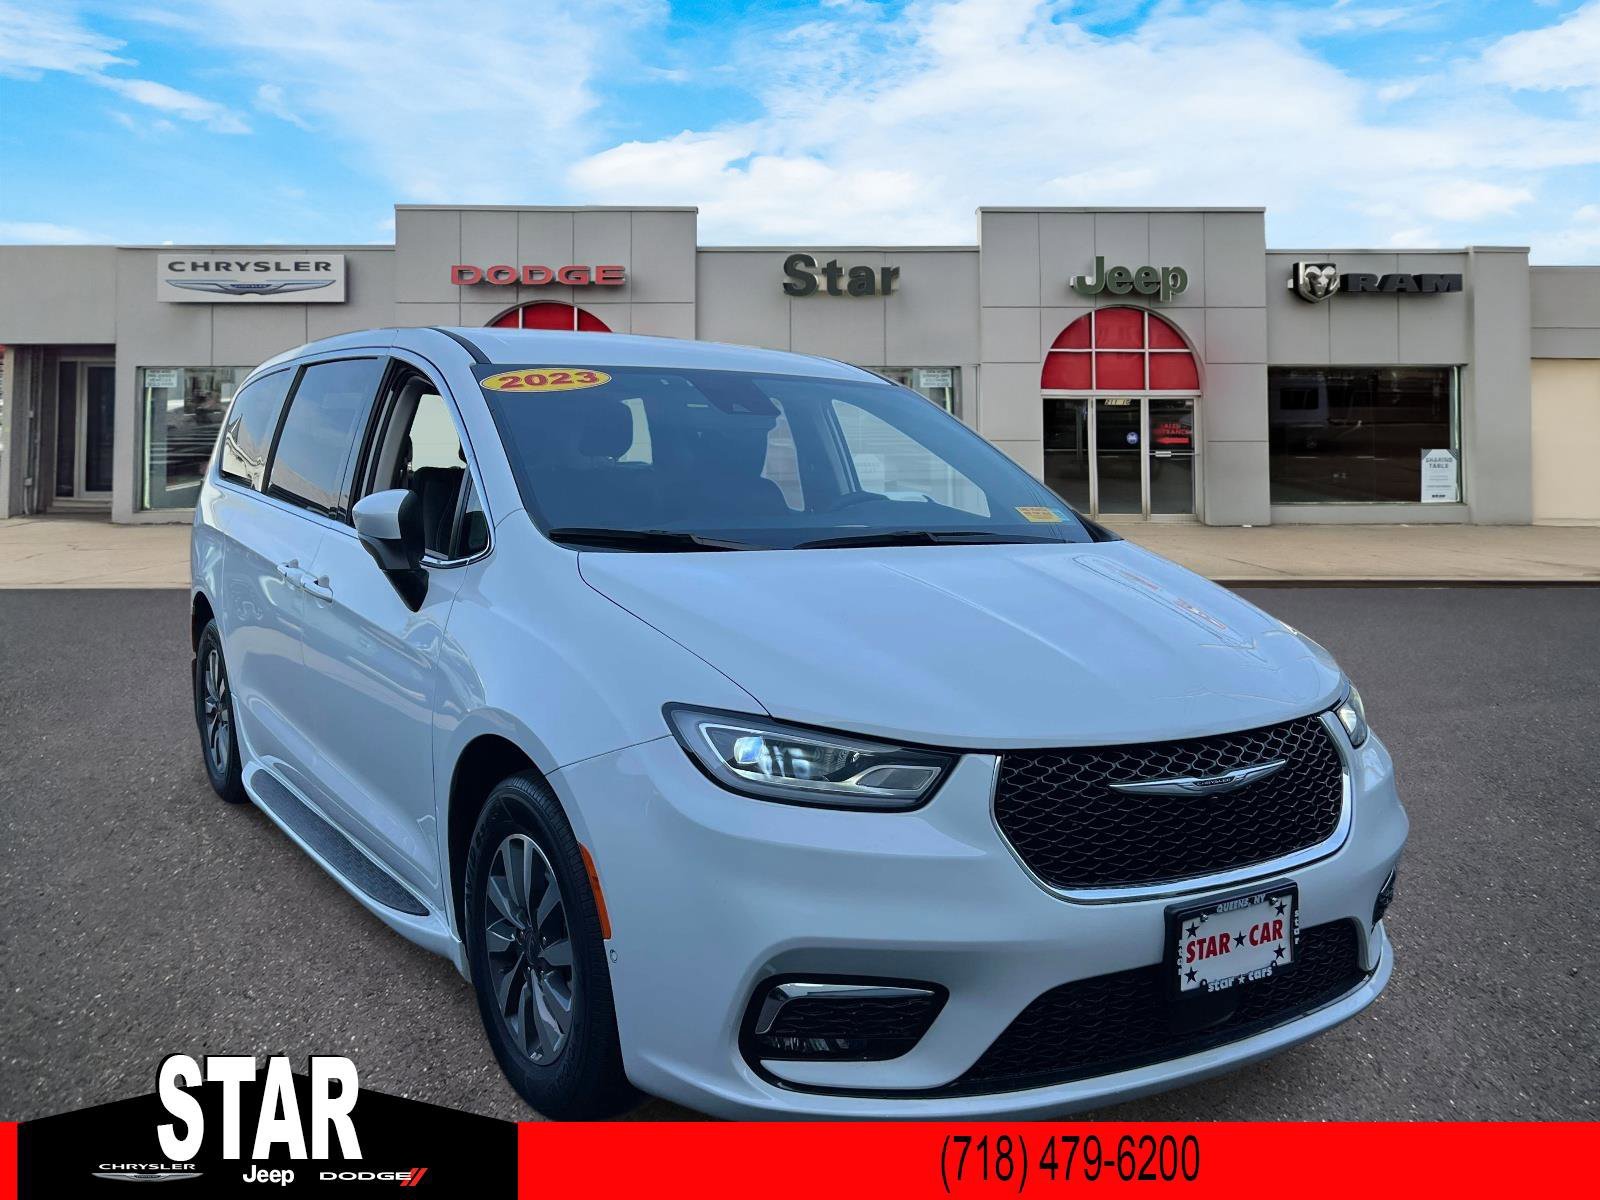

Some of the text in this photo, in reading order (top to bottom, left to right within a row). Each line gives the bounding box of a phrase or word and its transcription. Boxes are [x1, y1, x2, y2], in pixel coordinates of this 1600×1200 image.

[168, 261, 332, 272] CHRYSLER
[451, 265, 626, 286] DODGE
[782, 253, 900, 297] Star
[1070, 256, 1188, 302] Jeep
[1341, 273, 1463, 292] RAM
[498, 371, 600, 389] 2023
[1186, 933, 1231, 964] STAR
[1249, 920, 1283, 947] CAR
